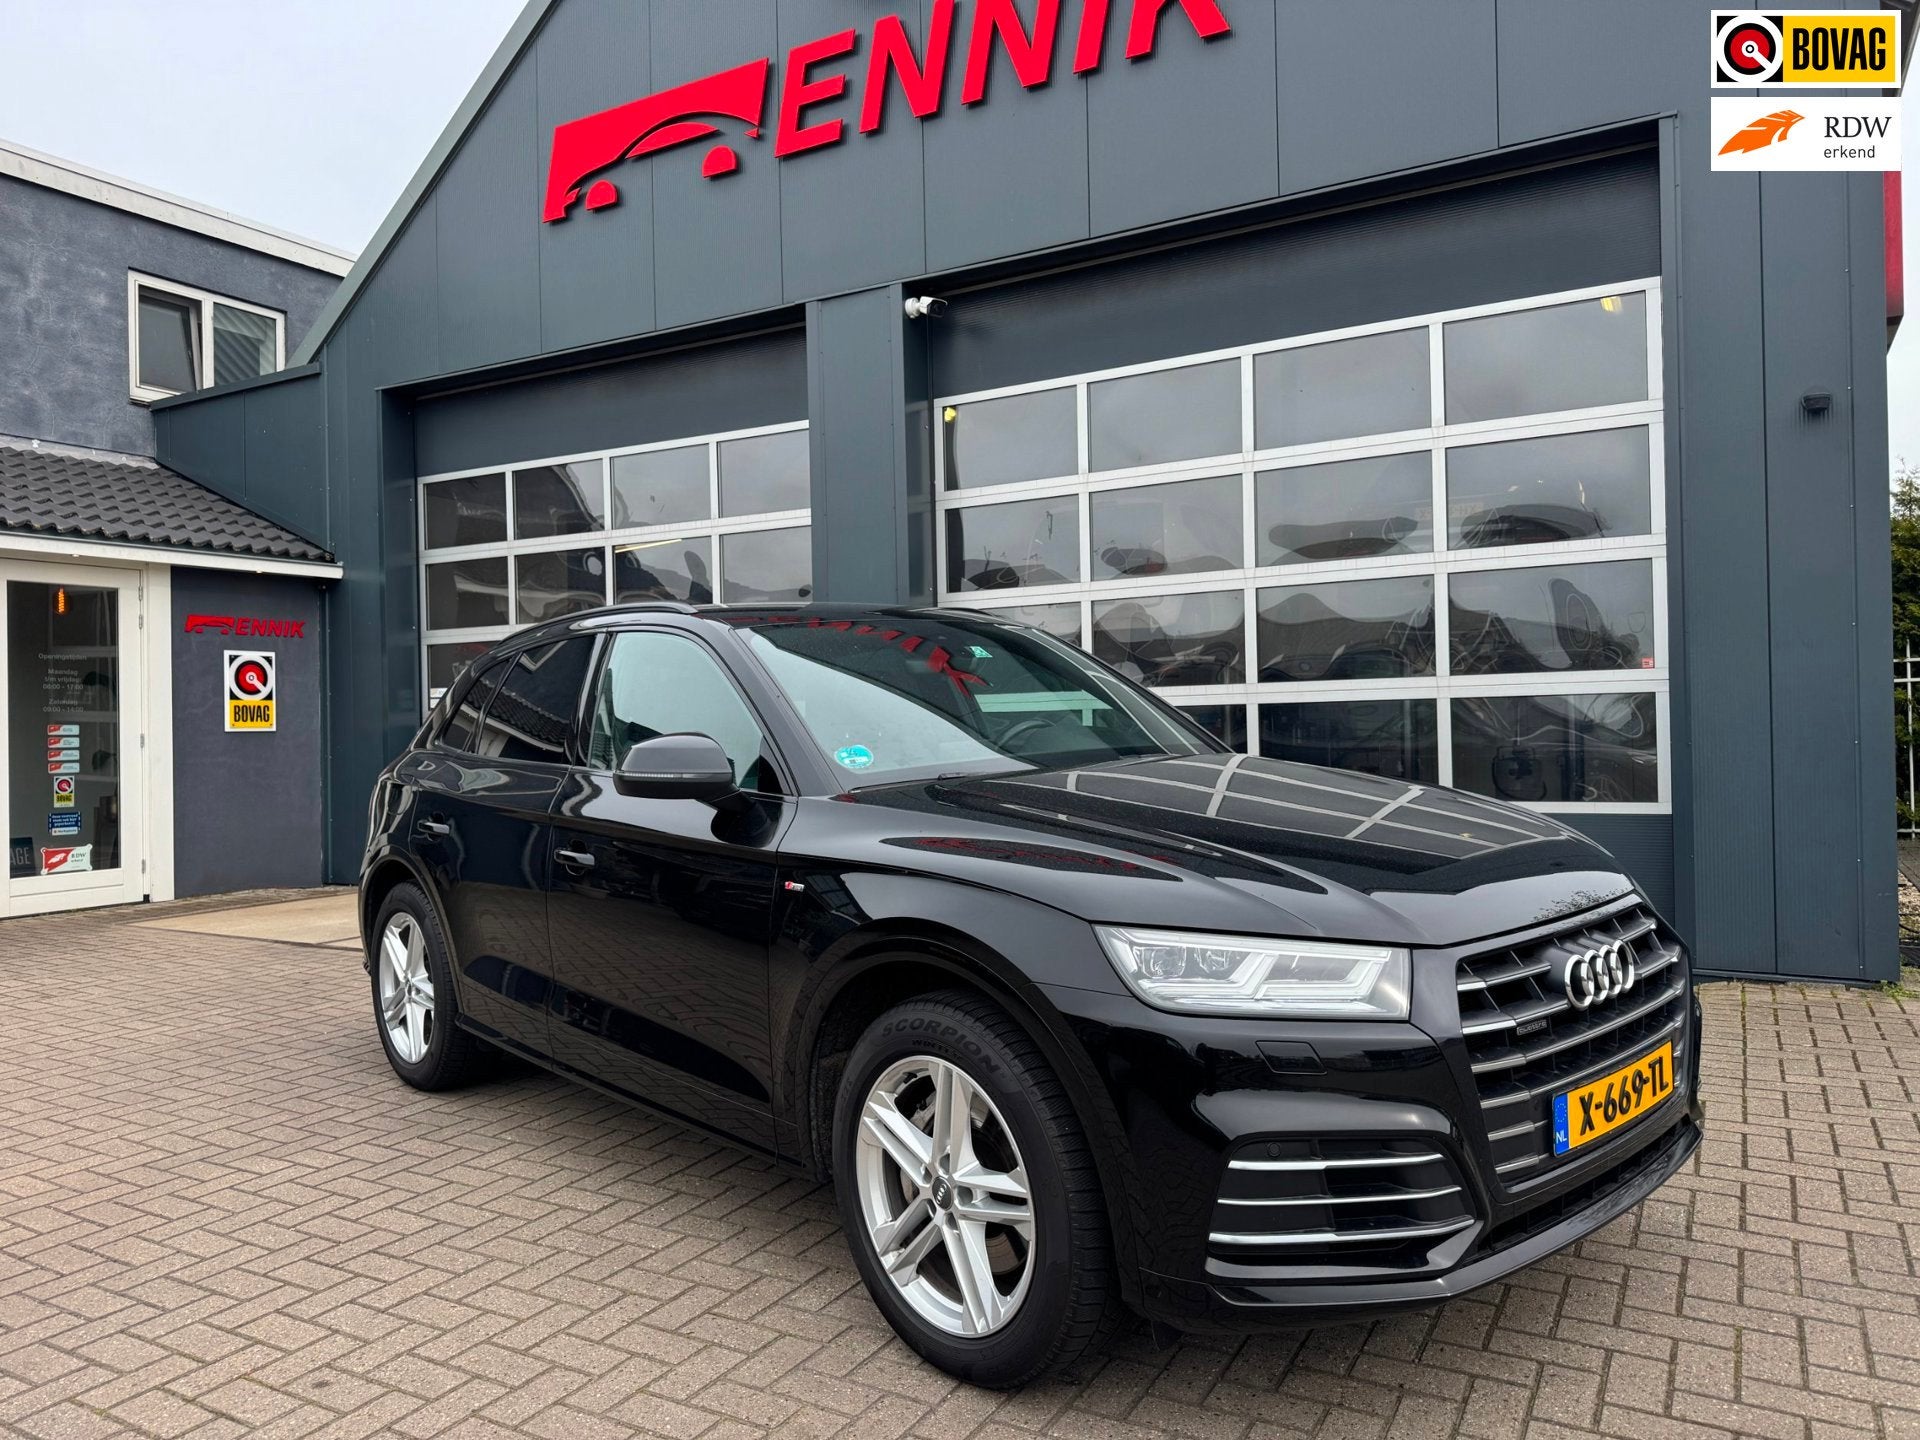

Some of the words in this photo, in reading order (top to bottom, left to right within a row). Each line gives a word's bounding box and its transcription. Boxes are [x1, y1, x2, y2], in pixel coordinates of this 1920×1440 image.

[233, 704, 270, 723] BOVAG
[882, 1018, 1001, 1074] SCORPION
[1579, 1056, 1669, 1136] X-669-TL
[1556, 1129, 1568, 1144] NL
